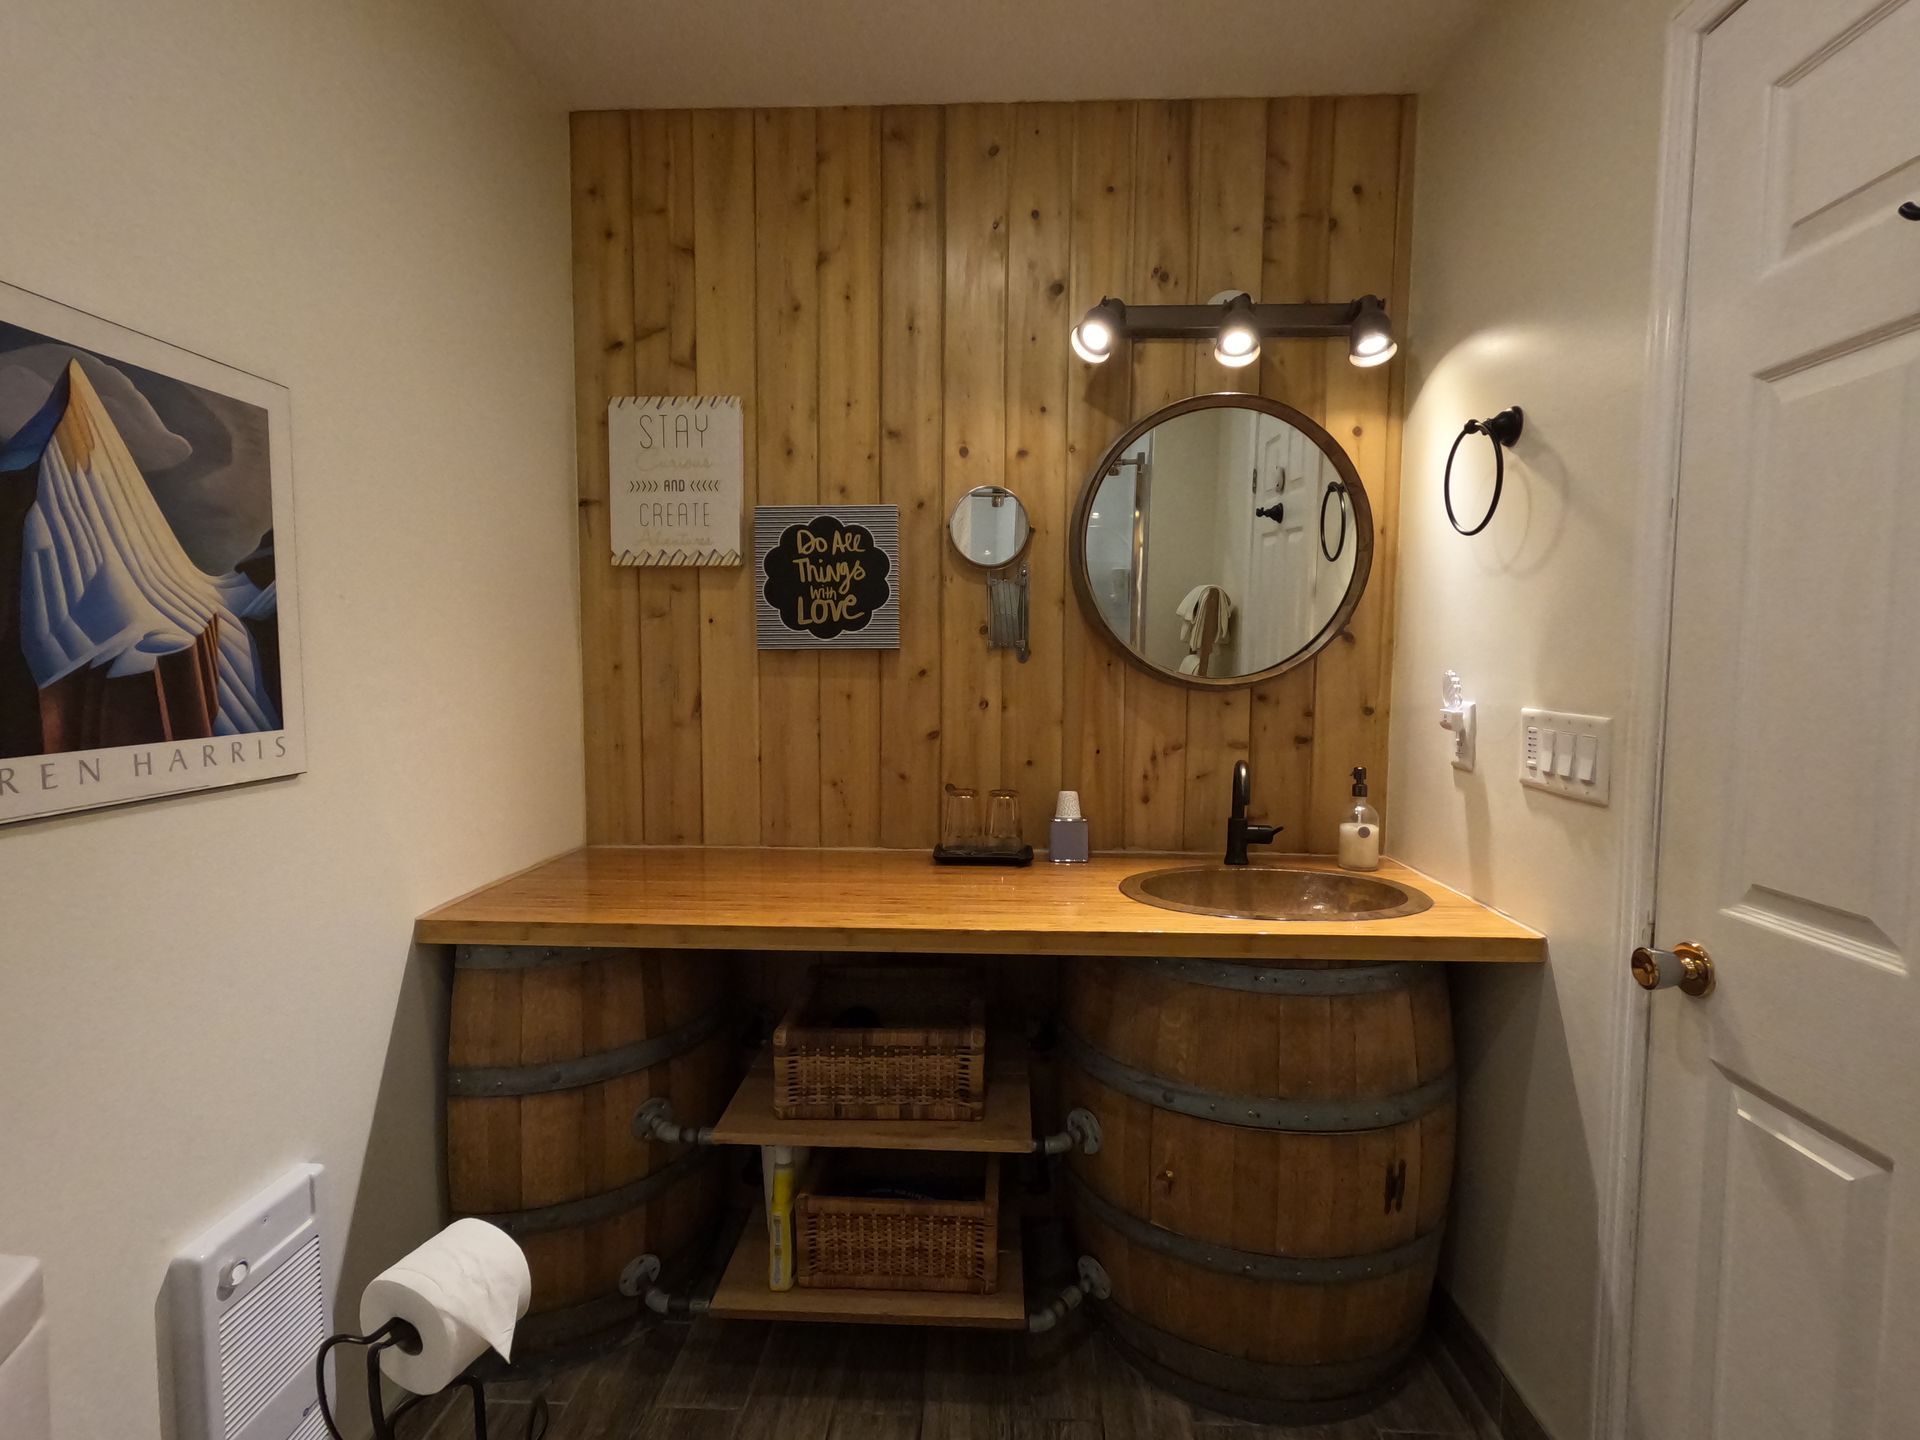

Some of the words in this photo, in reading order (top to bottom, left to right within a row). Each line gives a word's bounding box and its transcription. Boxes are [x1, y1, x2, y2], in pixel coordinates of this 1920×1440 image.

[639, 413, 710, 450] STAY
[663, 479, 686, 493] AND
[639, 502, 710, 528] CREATE
[796, 529, 828, 555] Do
[832, 530, 866, 555] All
[792, 557, 866, 595] Things
[809, 584, 837, 600] with
[133, 736, 287, 777] HARRIS
